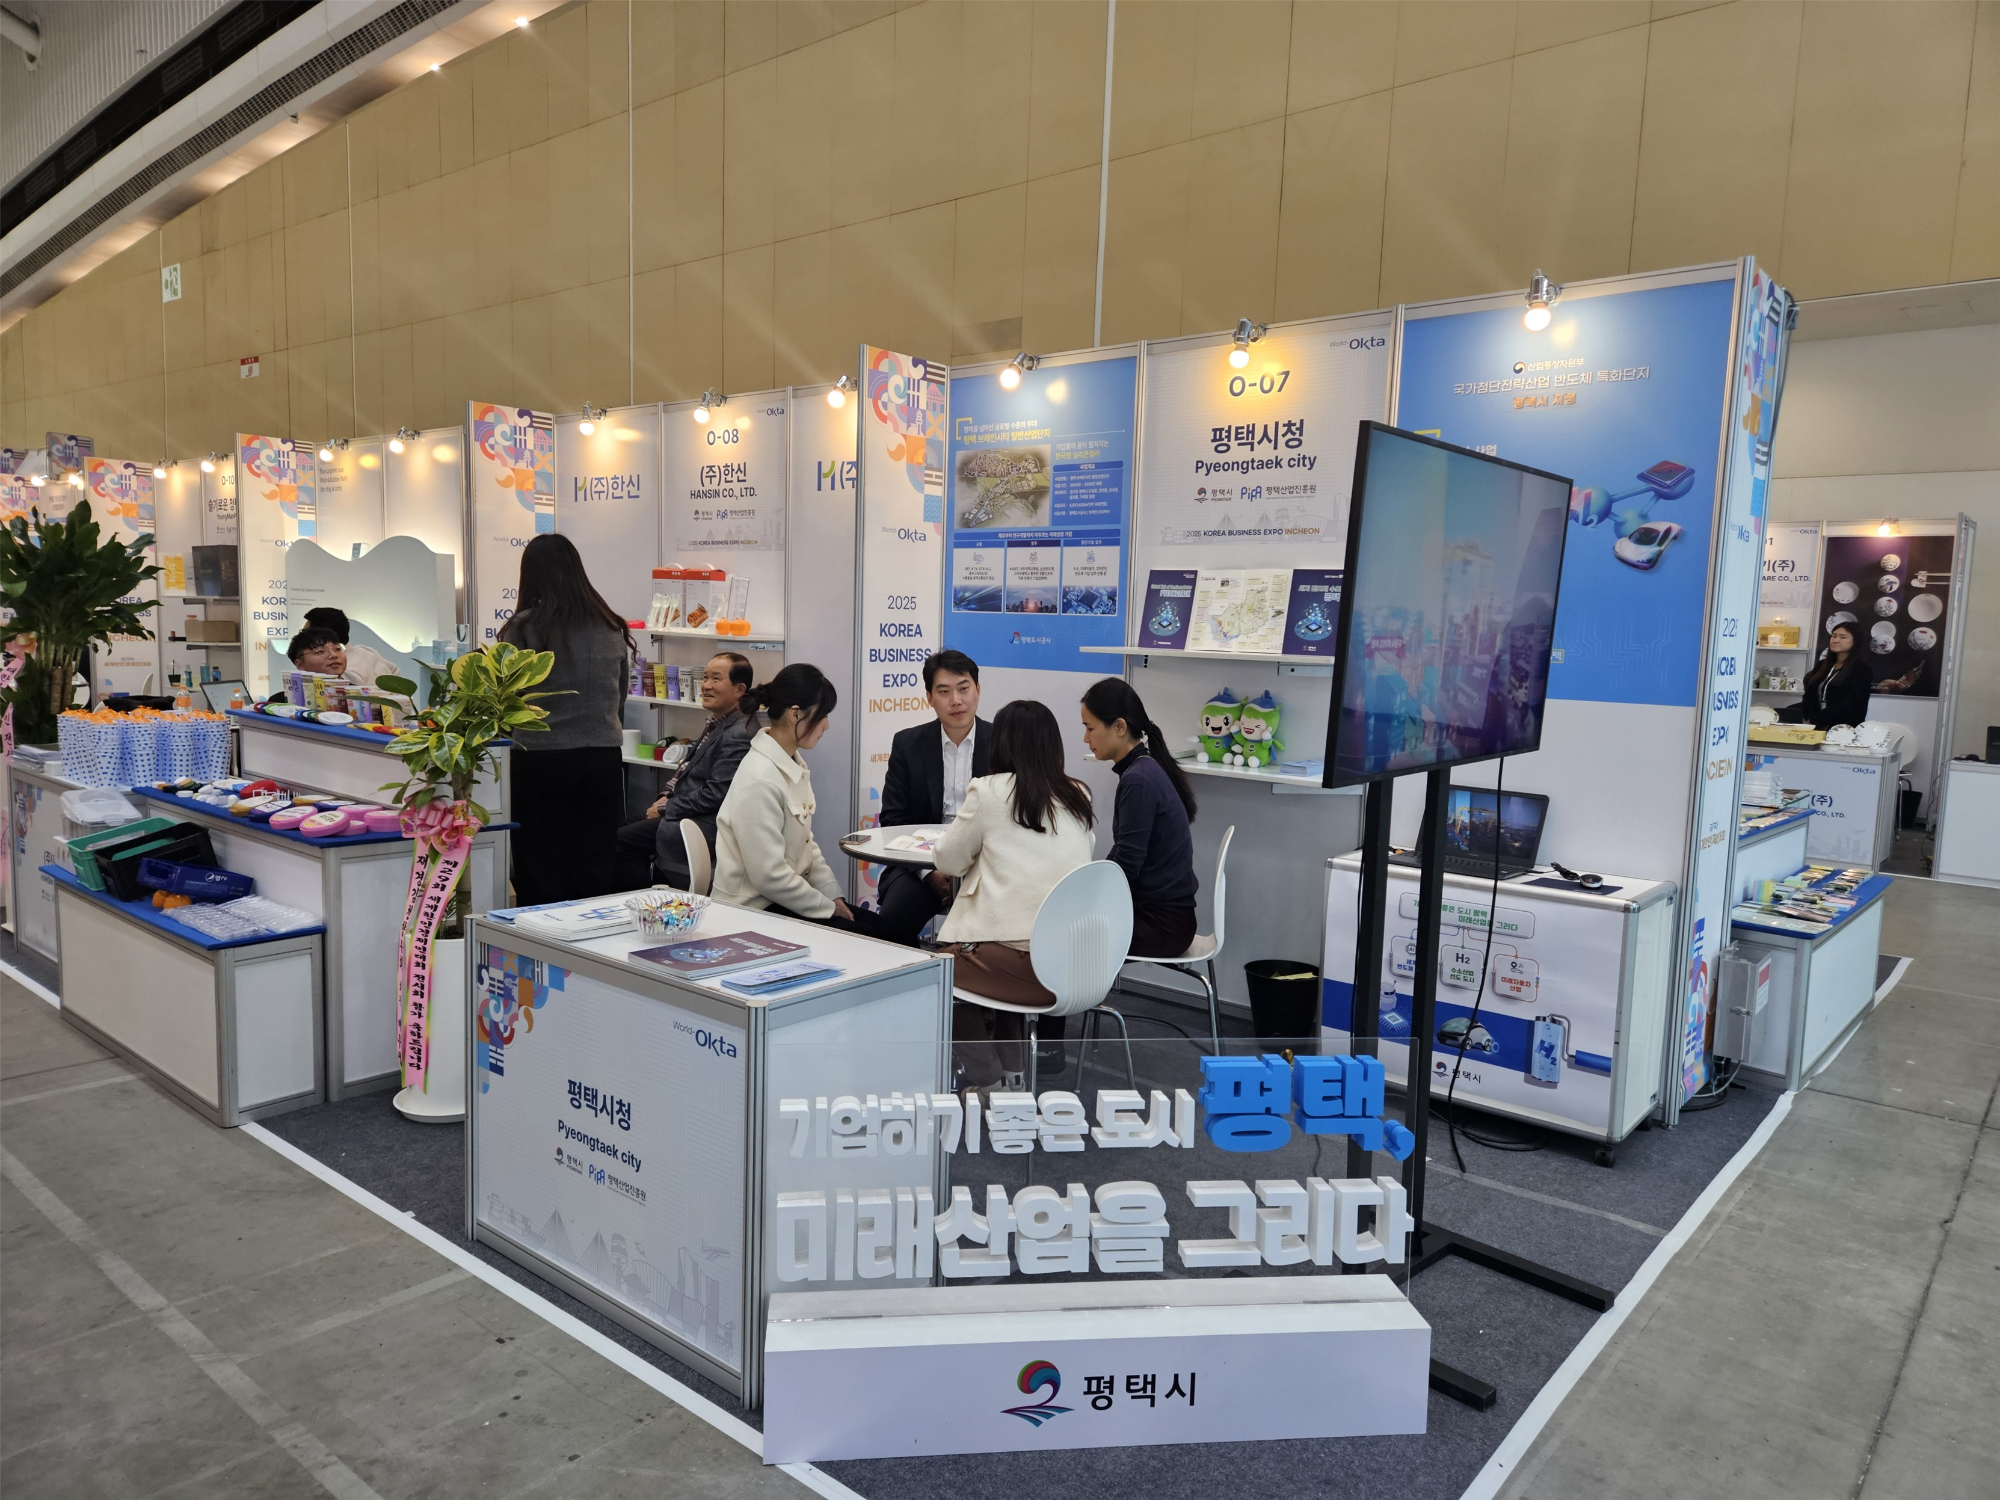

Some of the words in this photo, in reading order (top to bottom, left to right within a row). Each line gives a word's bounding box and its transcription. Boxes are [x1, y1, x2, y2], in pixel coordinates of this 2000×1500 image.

[1527, 357, 1585, 372] 산업통상자원부
[1453, 375, 1550, 396] 국가첨단전략산업
[1554, 371, 1593, 388] 반도체
[1596, 366, 1651, 384] 특화단지
[977, 432, 1010, 444] 브레인시티
[1010, 428, 1051, 442] 일반산업단지
[1210, 418, 1305, 454] 평택시청
[1195, 455, 1284, 477] Pyeongtaek
[1287, 453, 1317, 471] city
[700, 461, 747, 487] (주)한신
[589, 474, 641, 501] (주)한신
[690, 488, 720, 500] HANSIN
[722, 487, 739, 500] CO.,
[740, 486, 757, 498] LTD.
[1211, 487, 1233, 497] 평택시
[1265, 483, 1317, 495] 평택산업진흥원
[208, 498, 228, 512] 슬기로운
[1186, 530, 1201, 538] 2025
[1203, 529, 1227, 537] KOREA
[1285, 527, 1320, 535] INCHEON
[268, 579, 288, 590] 202
[261, 596, 287, 606] KOR
[502, 588, 518, 600] 20
[887, 595, 917, 611] 2025
[253, 611, 288, 621] BUSIN
[266, 627, 288, 636] EXP
[879, 622, 923, 638] KOREA
[869, 647, 932, 663] BUSINESS
[1551, 650, 1563, 661] 택
[882, 673, 918, 688] EXPO
[868, 697, 932, 713] INCHEON
[431, 859, 459, 892] 제29회
[1457, 906, 1472, 916] 도시
[1473, 908, 1488, 918] 평택
[1496, 921, 1519, 932] 그리다
[1449, 974, 1462, 982] 선도
[1462, 976, 1475, 984] 도시
[1450, 967, 1475, 976] 수소산업
[1501, 976, 1531, 988] 미래자동차
[1509, 985, 1522, 993] 산업
[567, 1078, 632, 1132] 평택시청
[779, 1091, 980, 1159] 기업하기
[985, 1089, 1089, 1155] 좋은
[1091, 1088, 1195, 1149] 도시
[558, 1119, 619, 1161] Pyeongtaek
[621, 1150, 642, 1173] city
[607, 1173, 647, 1202] 평택산업진흥원
[775, 1180, 1170, 1283] 미래산업을
[1177, 1175, 1414, 1268] 그리다
[1082, 1371, 1197, 1412] 평택시
